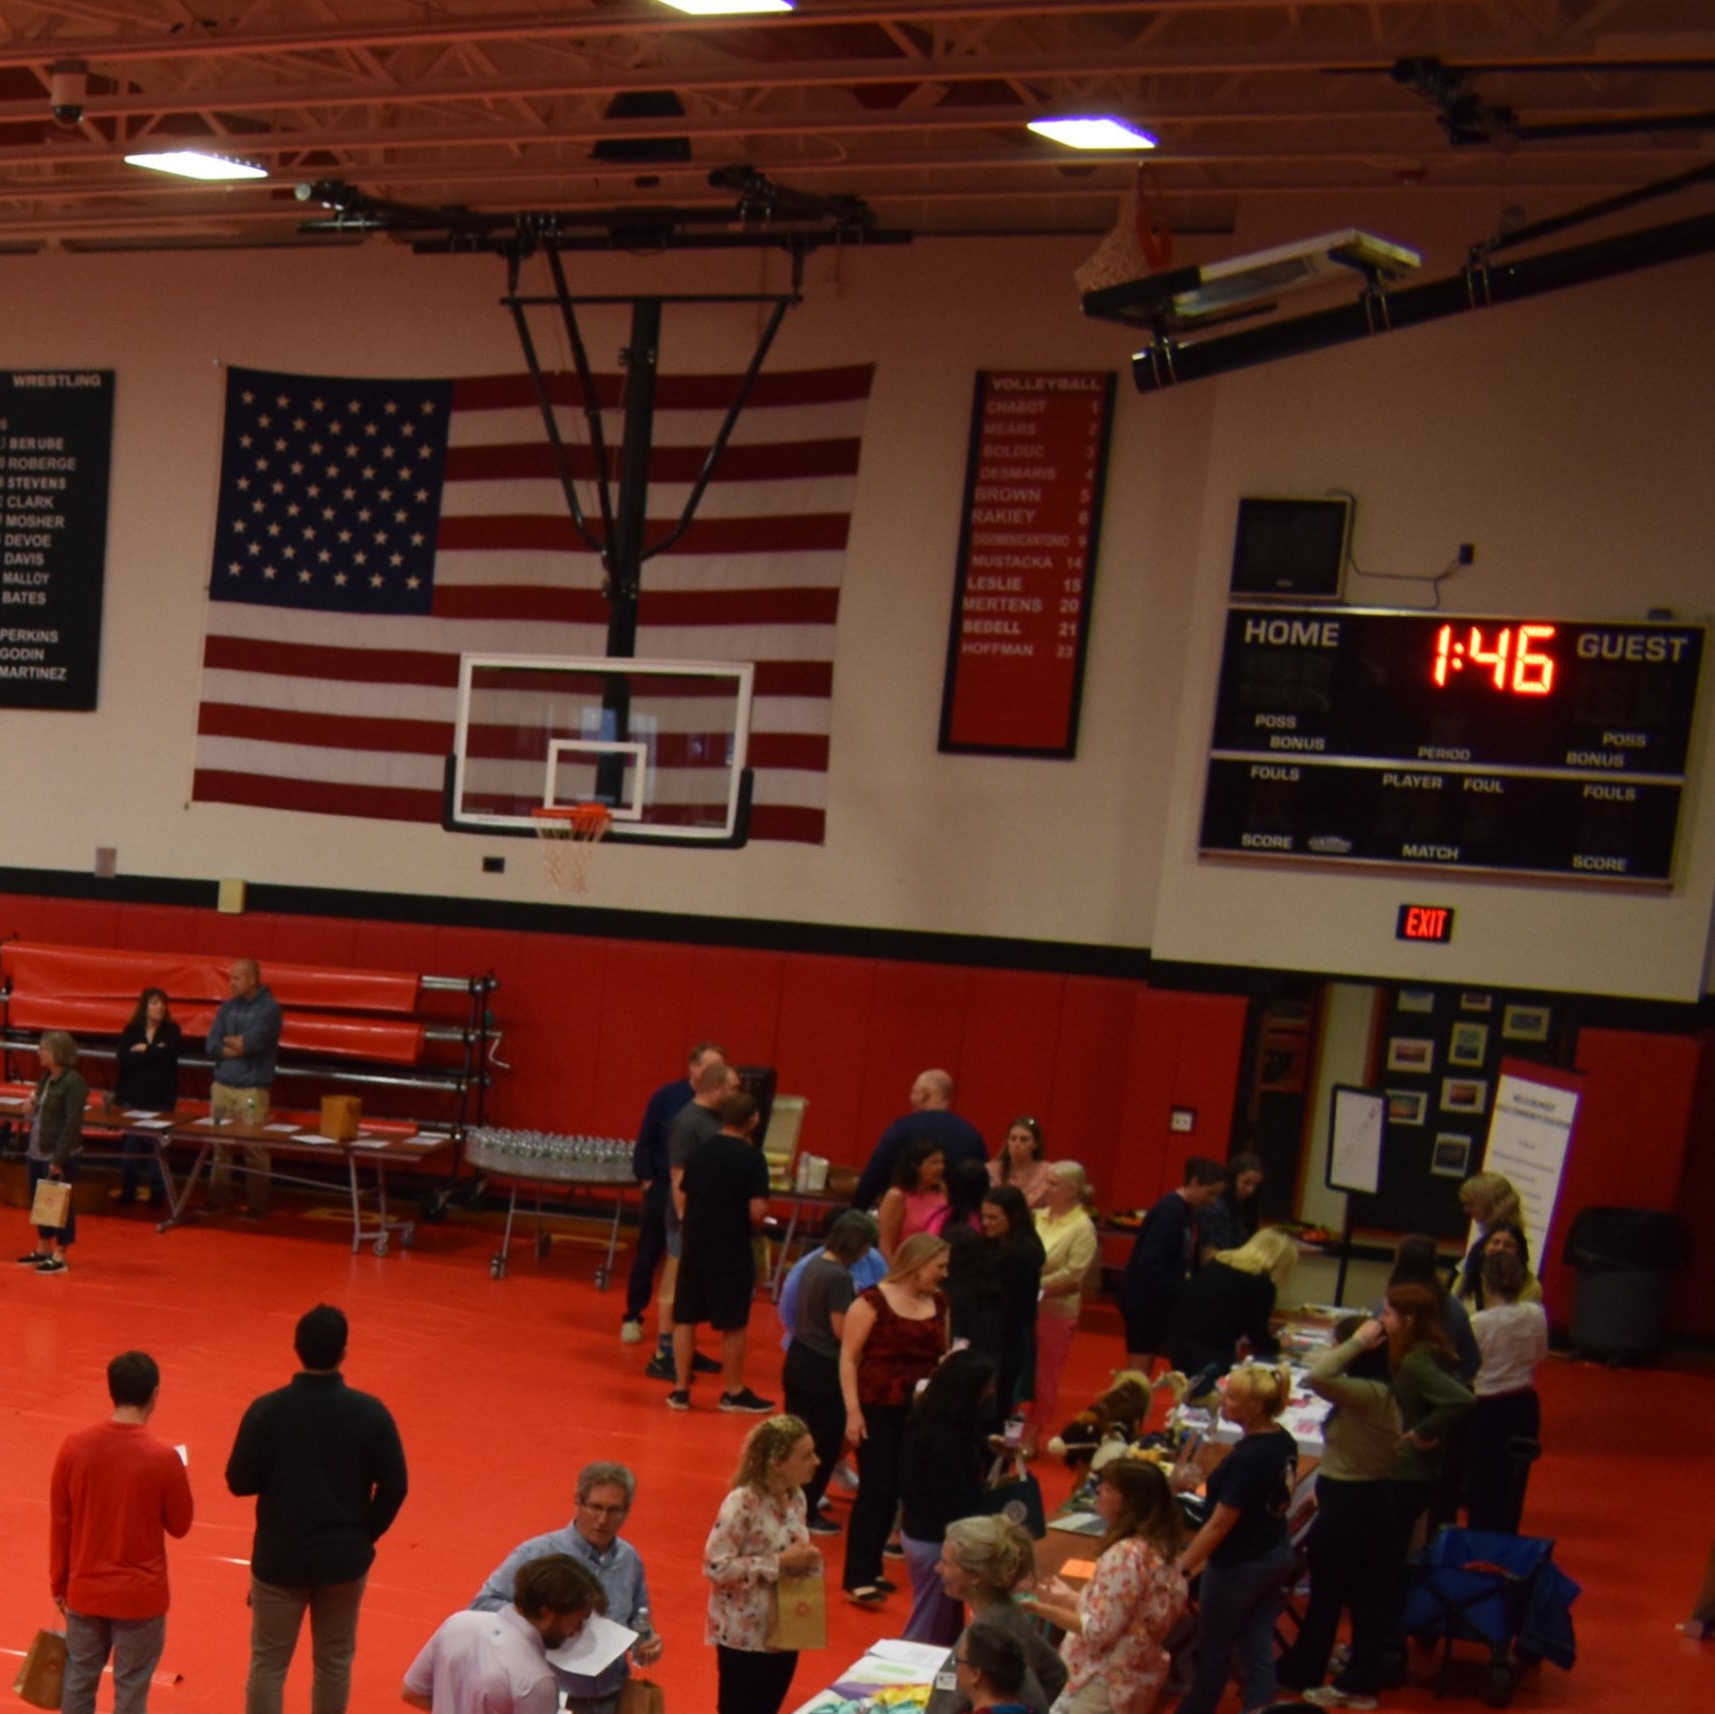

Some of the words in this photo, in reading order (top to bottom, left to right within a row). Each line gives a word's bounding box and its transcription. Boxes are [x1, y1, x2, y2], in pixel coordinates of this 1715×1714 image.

[13, 374, 101, 387] WRESTLING
[992, 378, 1101, 391] VOLLEYBALL
[1244, 618, 1340, 647] HOME
[1577, 633, 1689, 662] GUEST
[1432, 624, 1556, 694] 1:46
[1255, 714, 1297, 729] POSS
[1270, 736, 1325, 751] BONUS
[1602, 732, 1646, 748] POSS
[1418, 747, 1471, 761] PERIOD
[1566, 752, 1625, 767] BONUS
[1251, 766, 1300, 781] FOULS
[1382, 773, 1443, 790] PLAYER
[1463, 778, 1504, 793] FOUL
[1583, 785, 1636, 801] FOULS
[1241, 833, 1293, 850] SCORE
[1402, 843, 1459, 861] MATCH
[1572, 855, 1627, 873] SCORE
[1406, 908, 1448, 938] EXIT
